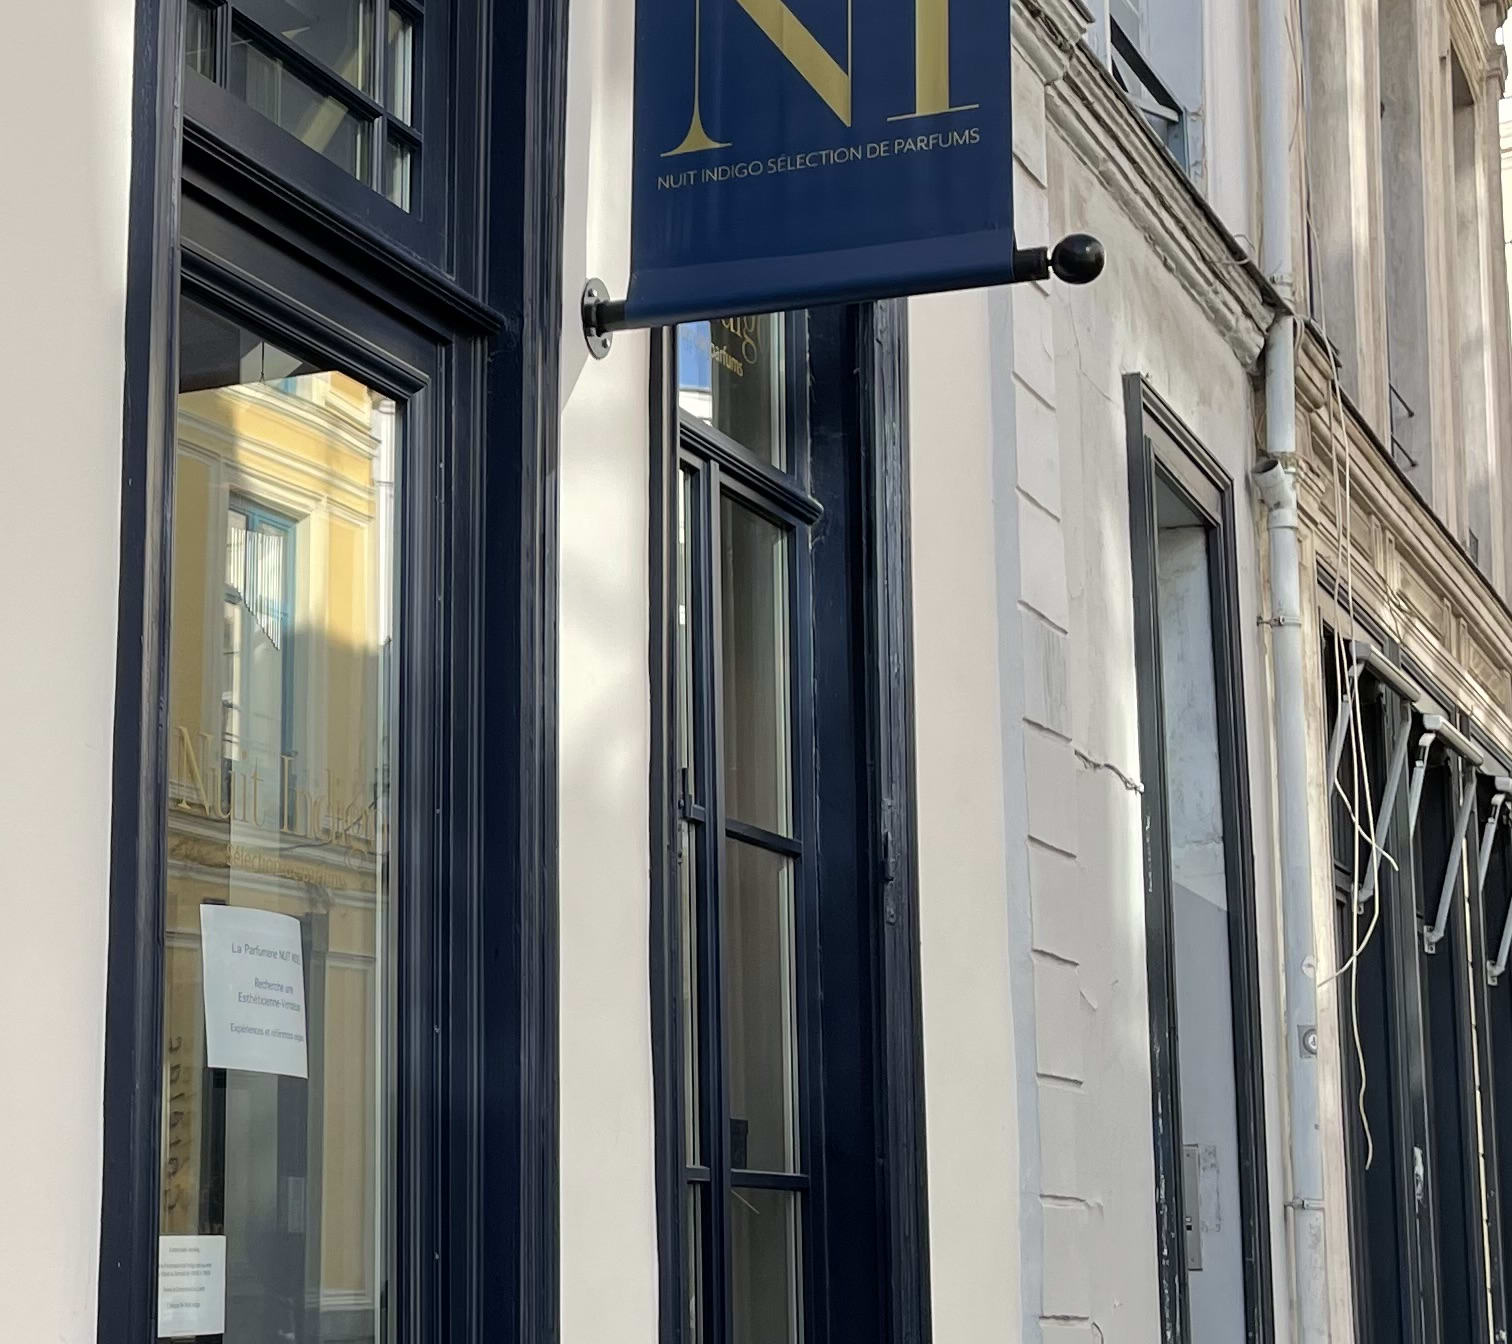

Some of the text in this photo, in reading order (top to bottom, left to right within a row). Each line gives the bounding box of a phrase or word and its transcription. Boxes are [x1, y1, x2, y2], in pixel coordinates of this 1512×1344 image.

[657, 127, 980, 190] NUIT INDIGO SÉLECTION DE PARFUMS
[176, 726, 265, 828] Nuit
